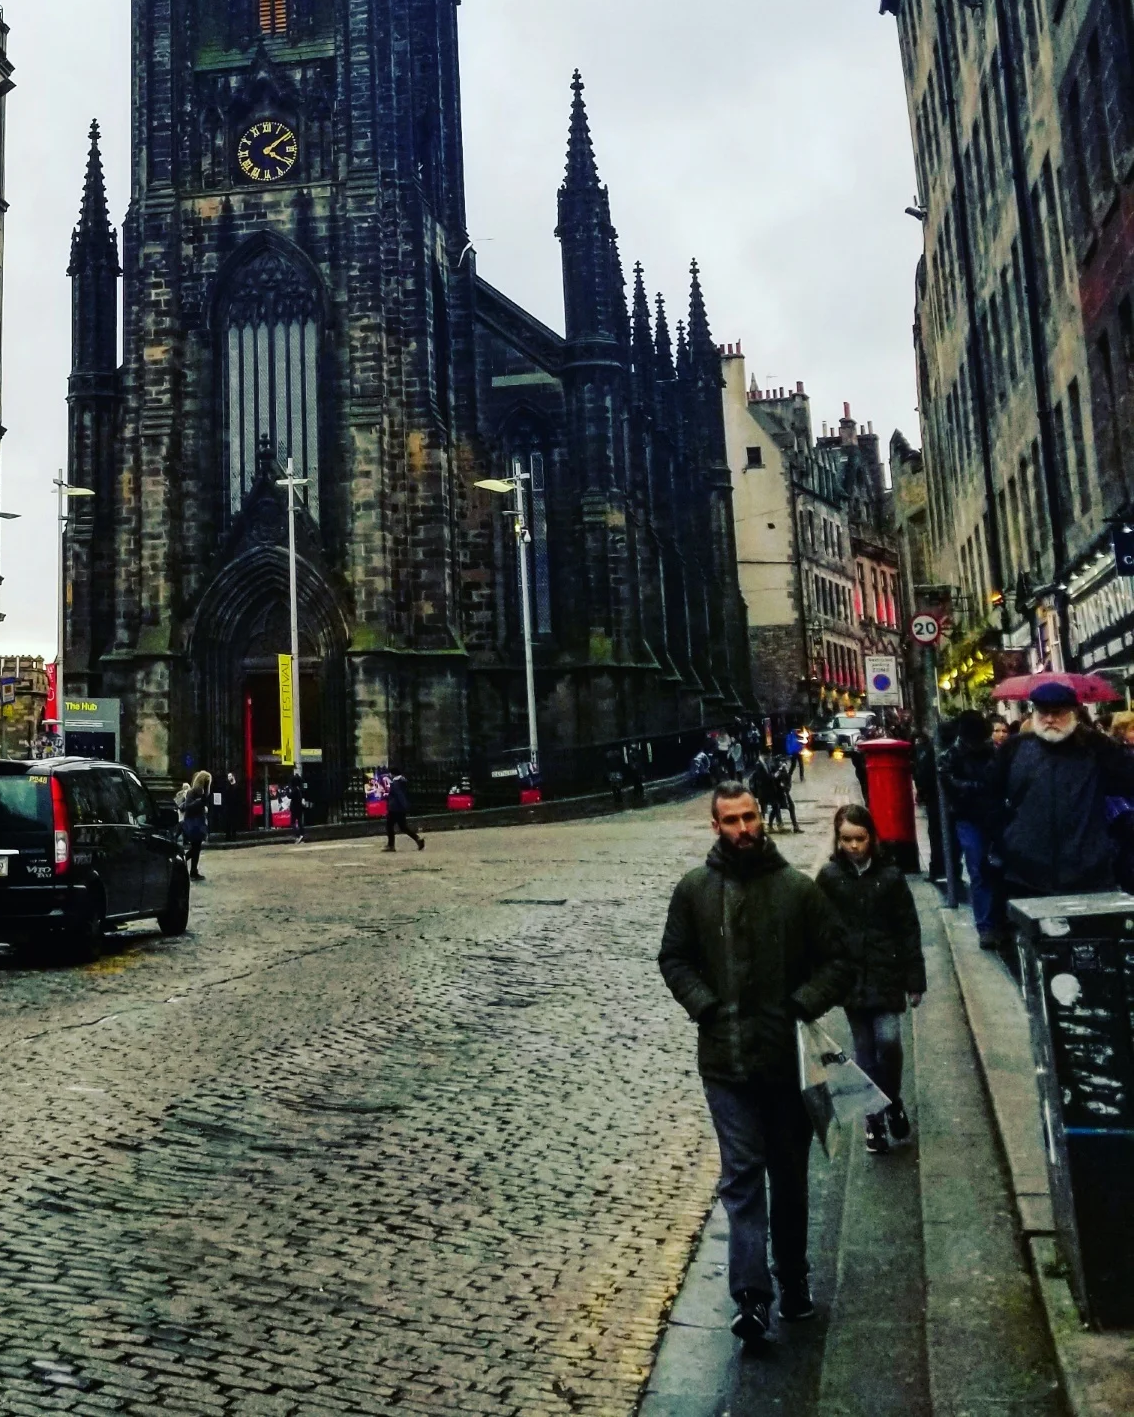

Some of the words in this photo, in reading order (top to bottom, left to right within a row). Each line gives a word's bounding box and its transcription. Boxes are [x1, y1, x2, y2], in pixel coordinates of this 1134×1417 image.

[913, 622, 937, 636] 20
[282, 661, 292, 719] FESTIVAL
[66, 701, 81, 711] The
[81, 702, 98, 711] Hub
[26, 865, 52, 874] VITO
